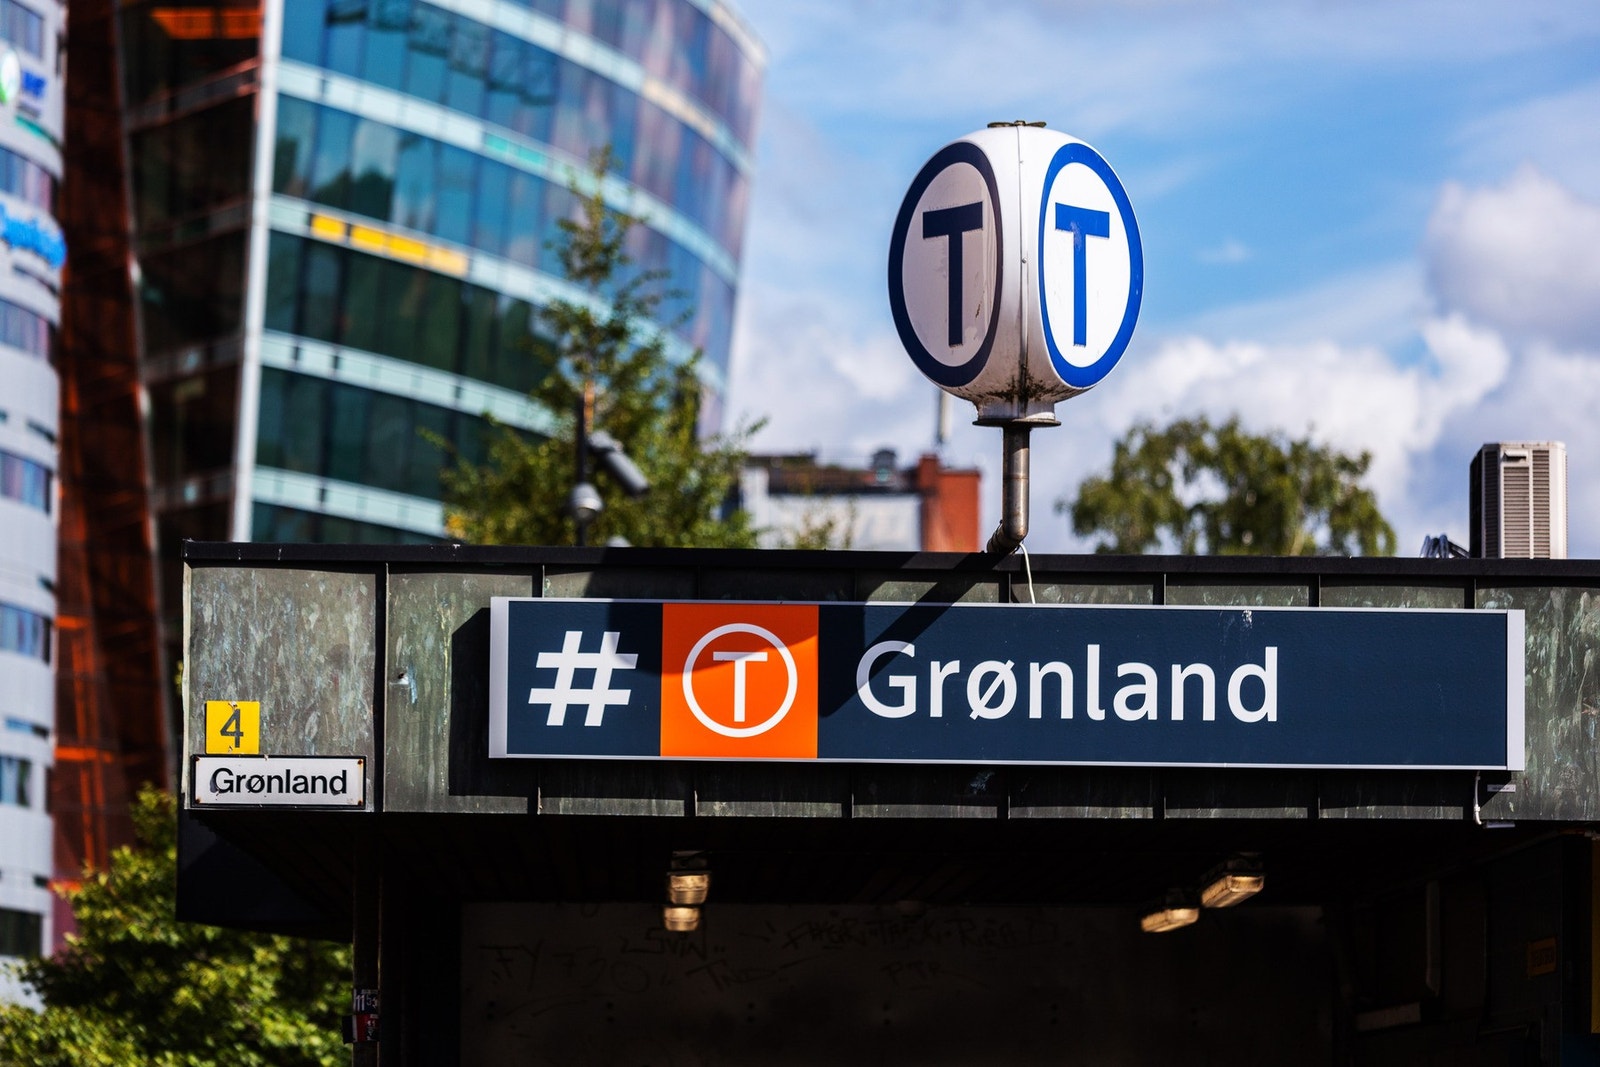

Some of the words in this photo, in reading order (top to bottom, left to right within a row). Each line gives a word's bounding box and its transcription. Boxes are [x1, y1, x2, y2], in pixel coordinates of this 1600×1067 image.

[923, 201, 983, 347] T
[1055, 202, 1110, 347] T
[856, 640, 1278, 723] Grønland
[220, 708, 244, 748] 4
[211, 767, 347, 796] Grønland
